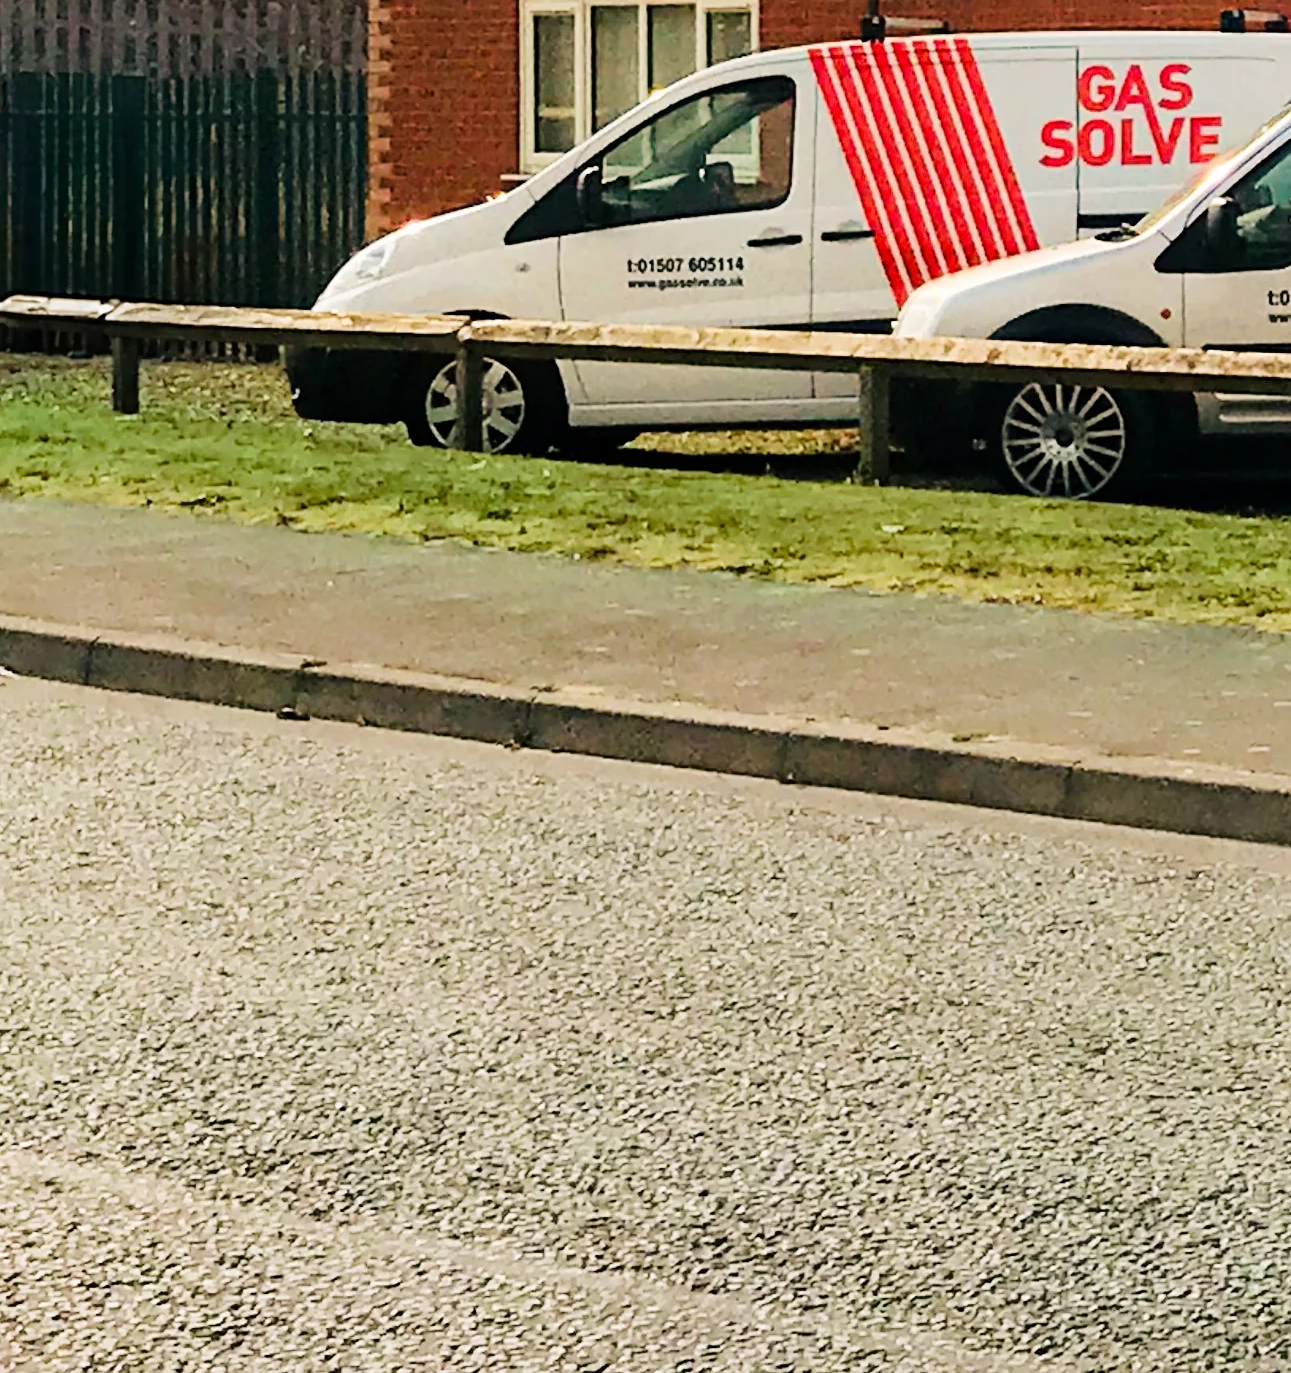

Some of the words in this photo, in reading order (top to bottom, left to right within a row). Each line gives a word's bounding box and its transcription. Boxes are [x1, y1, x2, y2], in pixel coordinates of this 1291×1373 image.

[1078, 63, 1193, 112] GAS
[1039, 116, 1222, 167] SOLVE
[627, 258, 683, 273] t:01507
[688, 256, 744, 272] 605114
